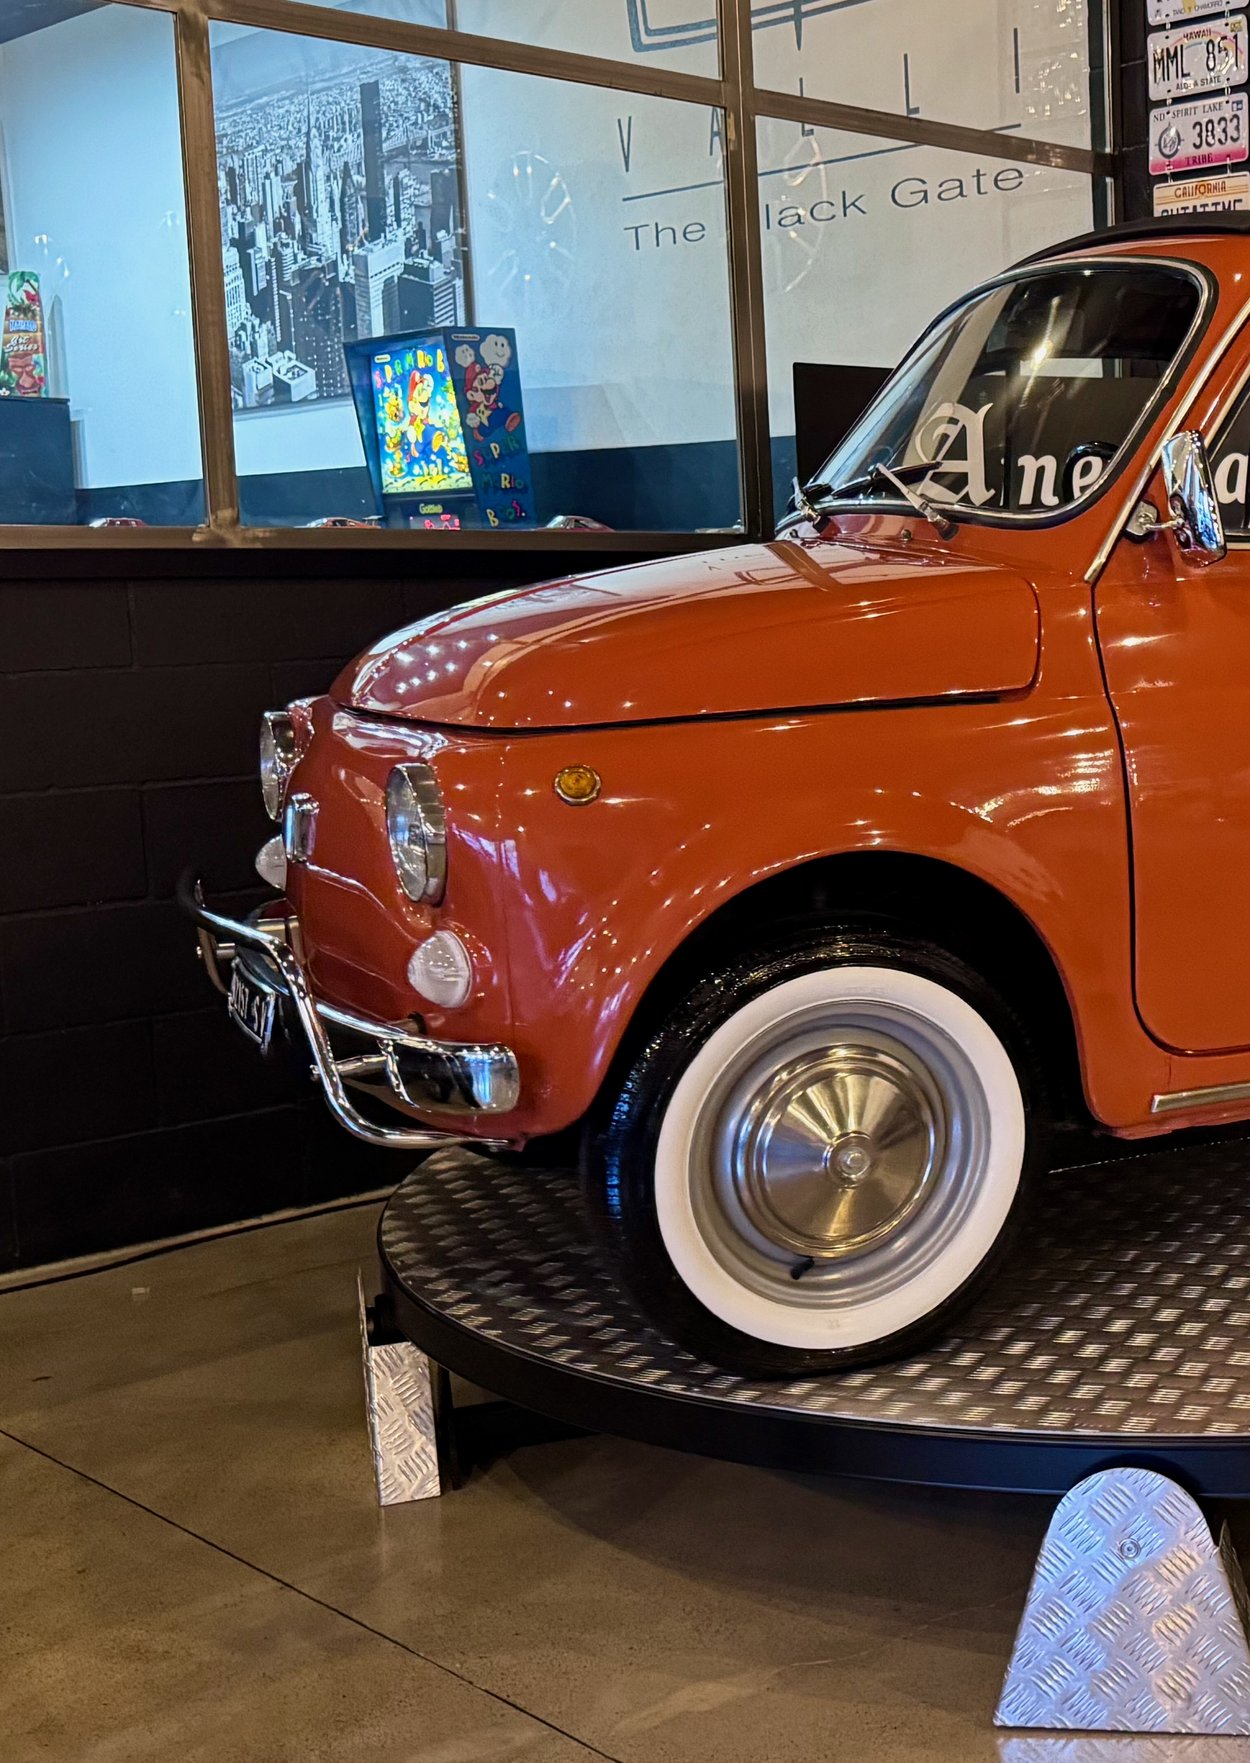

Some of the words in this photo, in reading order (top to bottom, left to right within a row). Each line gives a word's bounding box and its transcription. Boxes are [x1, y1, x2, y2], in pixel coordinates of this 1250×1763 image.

[1183, 28, 1212, 41] HAWAII
[1153, 44, 1191, 83] MML
[1206, 34, 1240, 72] 851
[1200, 75, 1221, 86] STATE
[1153, 111, 1165, 122] ND
[1172, 106, 1198, 119] SPIRIT
[1203, 103, 1224, 114] LAKE
[1192, 114, 1241, 150] 3833
[1185, 152, 1214, 166] TRIBE
[1174, 180, 1226, 199] CALIFORNIA
[624, 221, 707, 251] The
[765, 190, 867, 231] lack
[890, 167, 1025, 209] Gate
